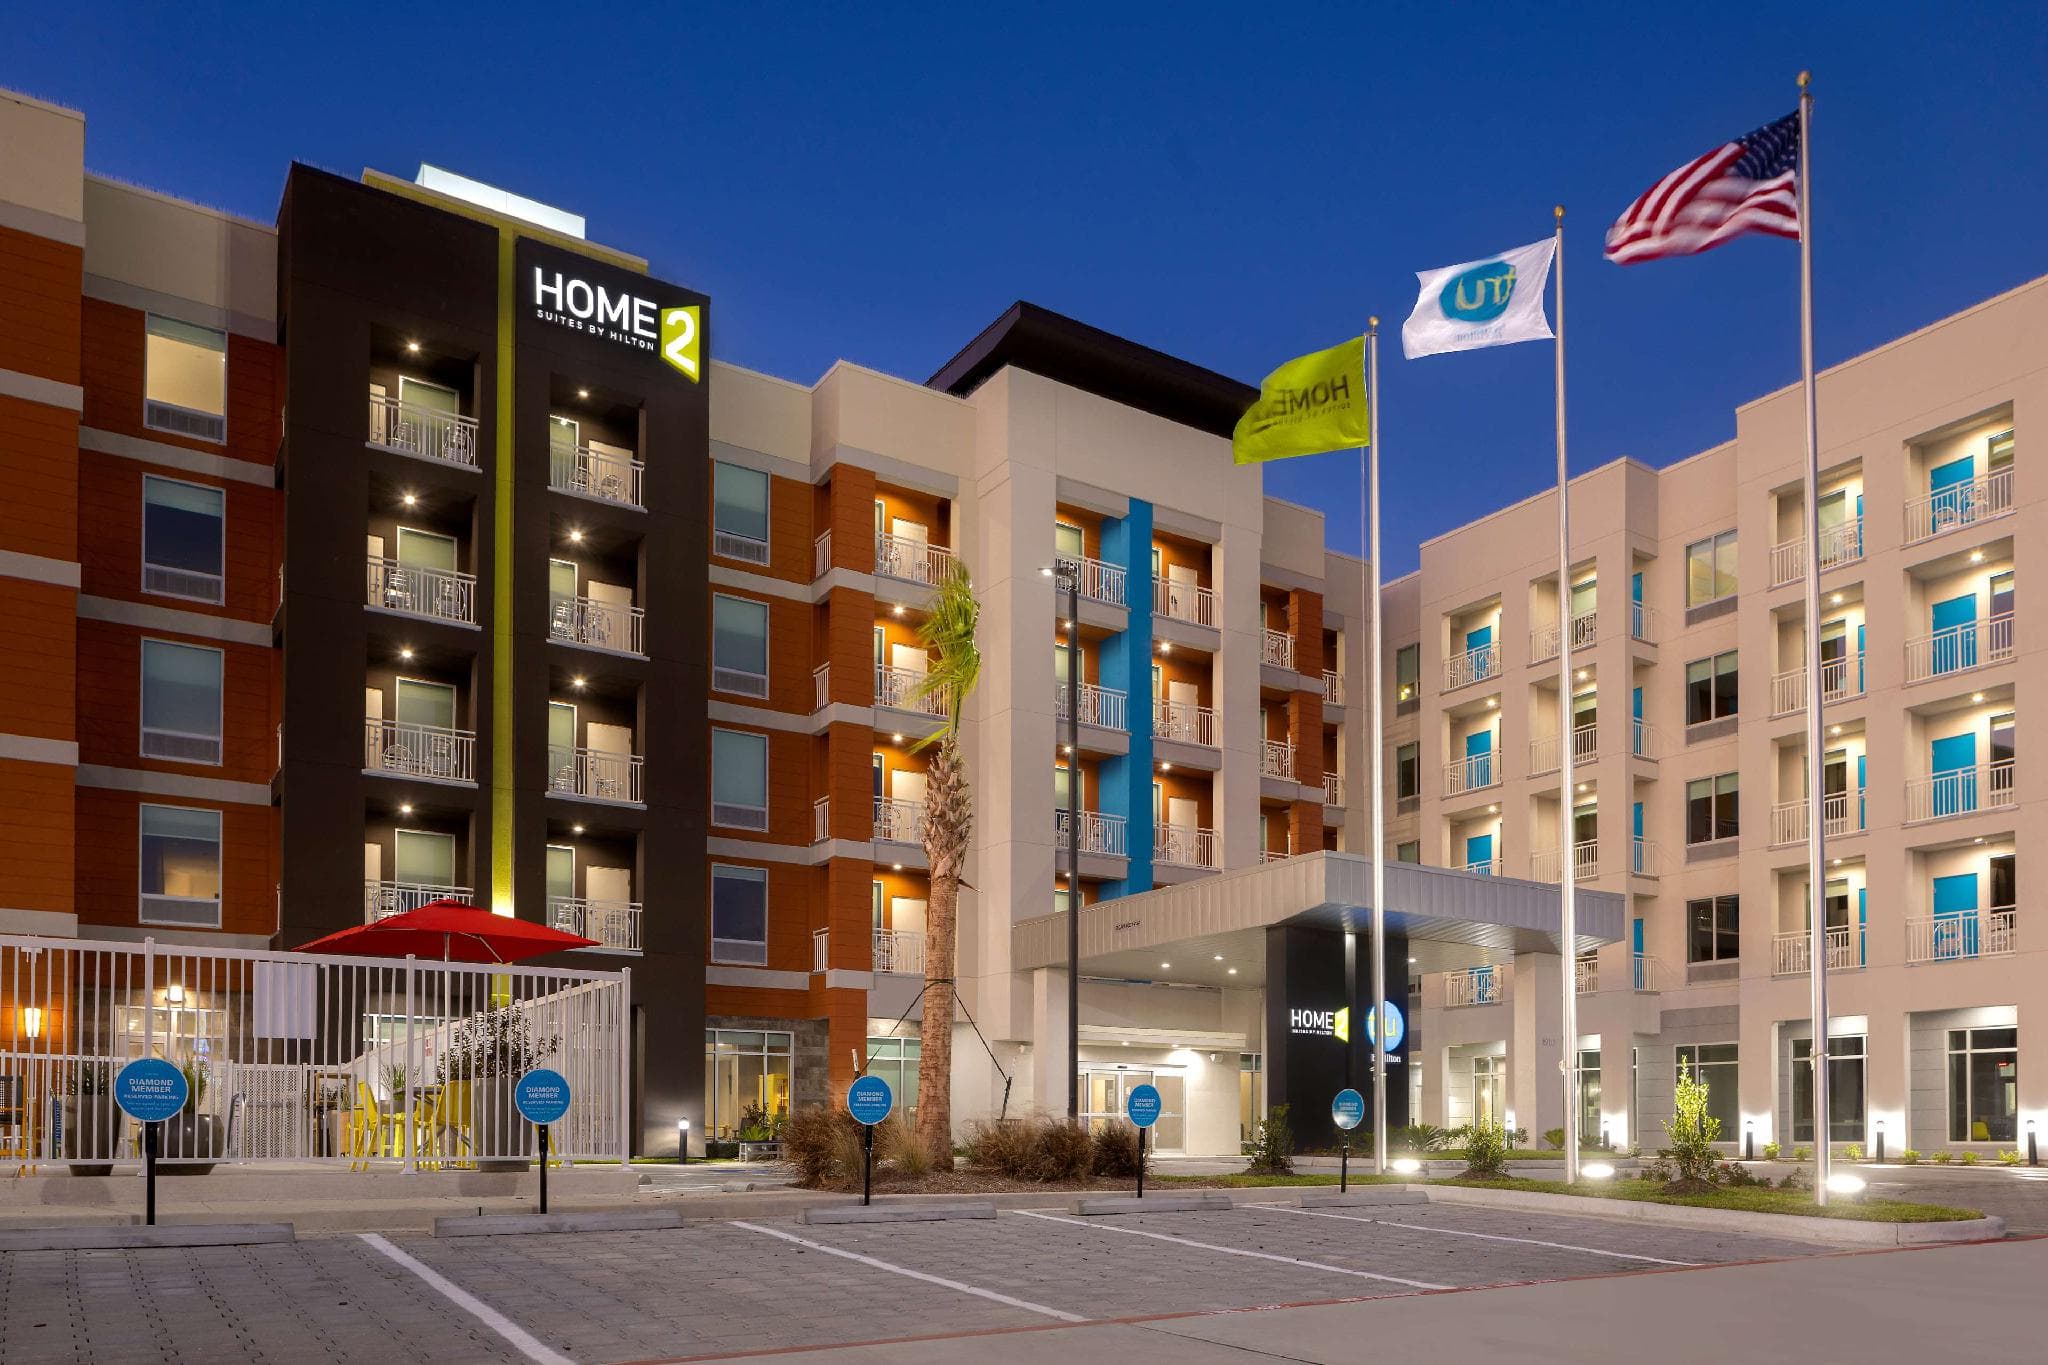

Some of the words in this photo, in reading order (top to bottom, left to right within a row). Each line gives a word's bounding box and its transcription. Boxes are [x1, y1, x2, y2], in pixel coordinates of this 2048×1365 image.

[535, 267, 657, 339] HOME
[537, 309, 583, 330] SUITES
[589, 324, 605, 337] BY
[610, 331, 654, 351] HILTON
[1291, 1008, 1335, 1029] HOME
[1383, 1054, 1401, 1063] ilton
[129, 1078, 174, 1086] DIAMOND
